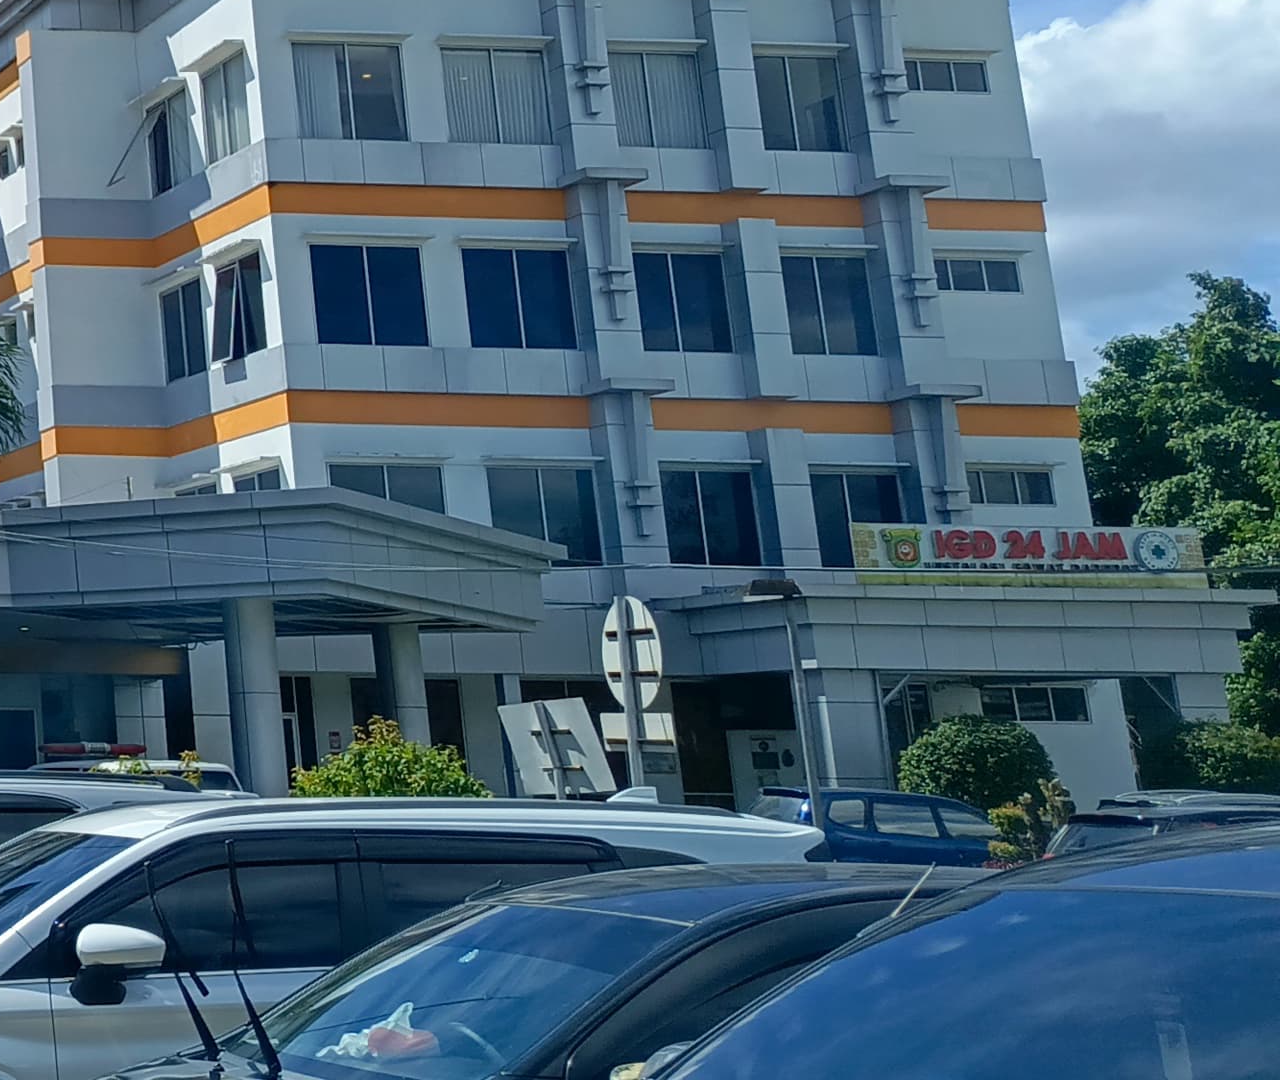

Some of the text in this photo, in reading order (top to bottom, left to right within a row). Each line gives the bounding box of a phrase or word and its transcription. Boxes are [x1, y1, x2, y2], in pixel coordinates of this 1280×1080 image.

[932, 529, 997, 559] IGD
[1003, 530, 1046, 559] 24
[1054, 531, 1129, 560] JAM
